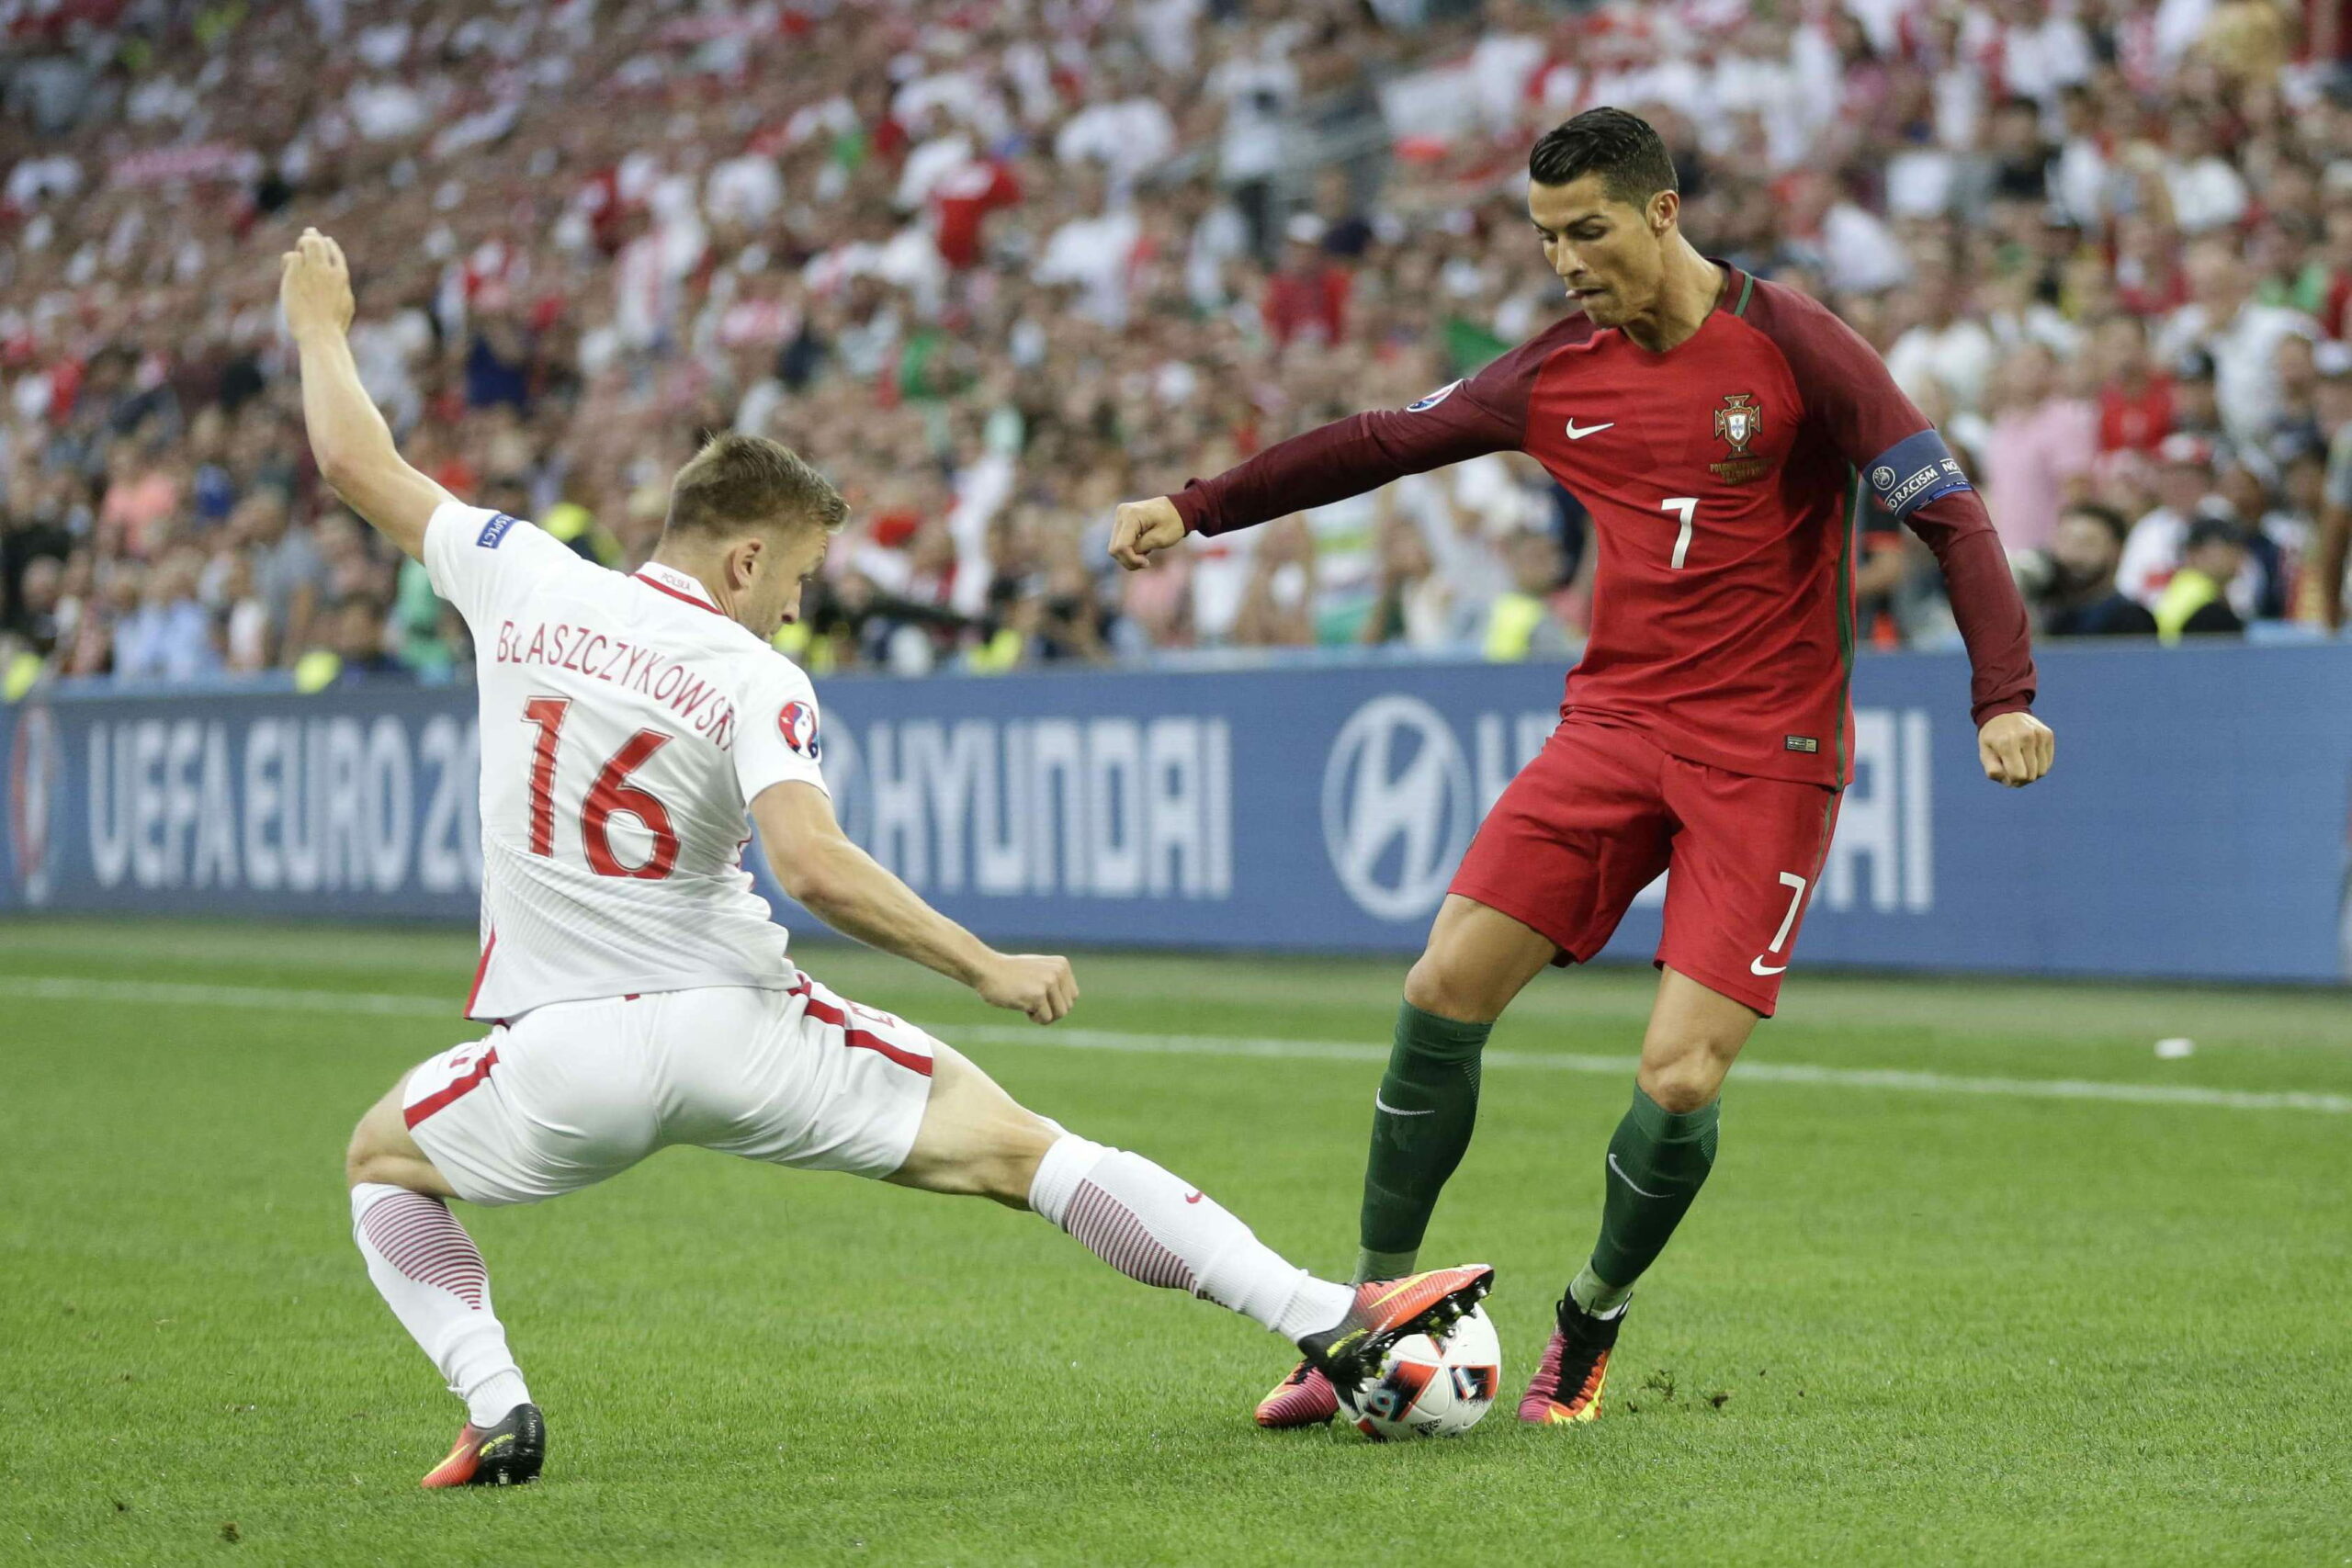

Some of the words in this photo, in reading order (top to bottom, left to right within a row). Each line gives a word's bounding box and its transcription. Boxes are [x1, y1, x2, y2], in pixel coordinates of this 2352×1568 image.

[1661, 497, 1700, 570] 7
[1894, 468, 1939, 502] RACISM
[88, 718, 239, 889] UEFA
[244, 716, 415, 891] EURO
[521, 695, 681, 880] 16
[867, 716, 1232, 900] HYUNDAI
[1768, 871, 1806, 953] 7
